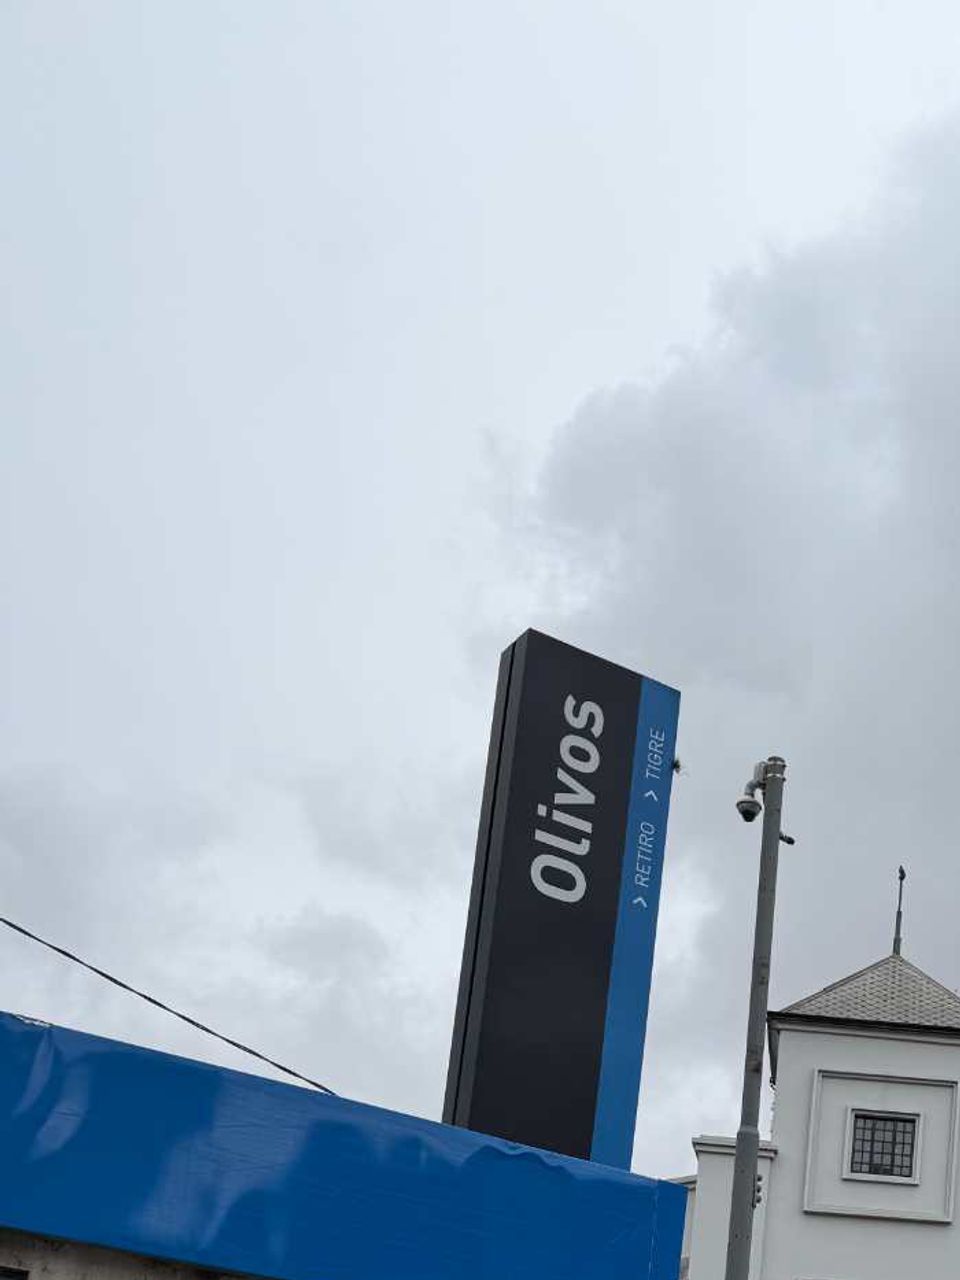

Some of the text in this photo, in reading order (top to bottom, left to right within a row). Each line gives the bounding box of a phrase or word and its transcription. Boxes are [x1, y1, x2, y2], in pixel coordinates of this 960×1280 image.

[530, 693, 606, 904] Olivos
[634, 728, 666, 888] RETIRO TIGRE
